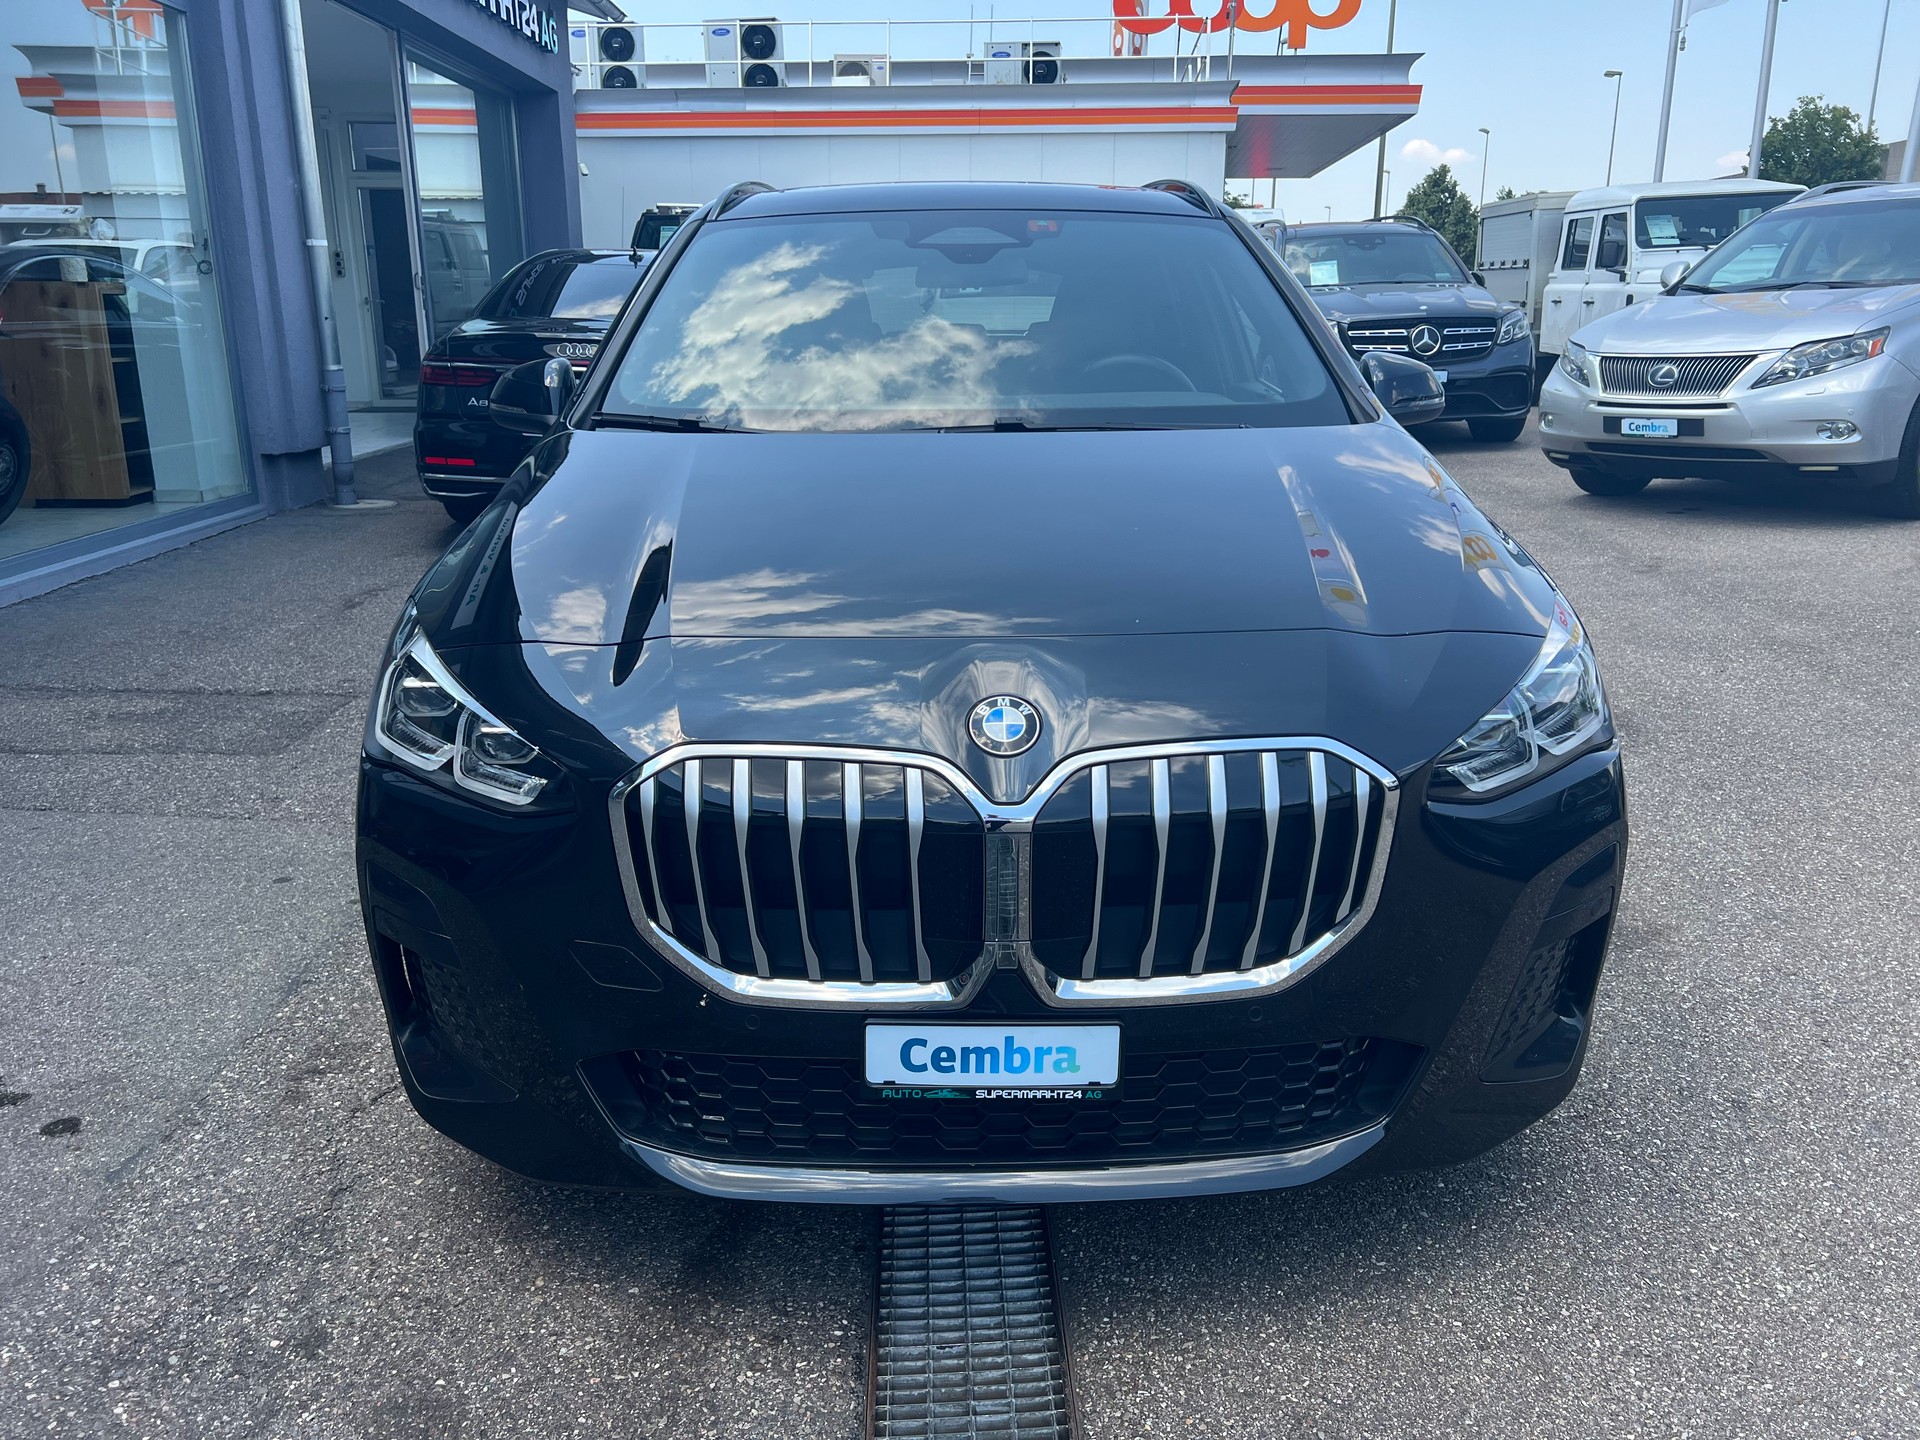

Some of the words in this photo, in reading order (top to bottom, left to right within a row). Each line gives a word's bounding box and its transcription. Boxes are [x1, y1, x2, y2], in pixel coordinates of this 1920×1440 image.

[541, 11, 559, 55] AG
[467, 397, 489, 407] A8
[1628, 422, 1669, 433] Cembra
[976, 697, 1033, 716] BMW
[899, 1035, 1081, 1074] Cembra
[882, 1089, 922, 1099] AUTO
[1085, 1090, 1102, 1099] AG
